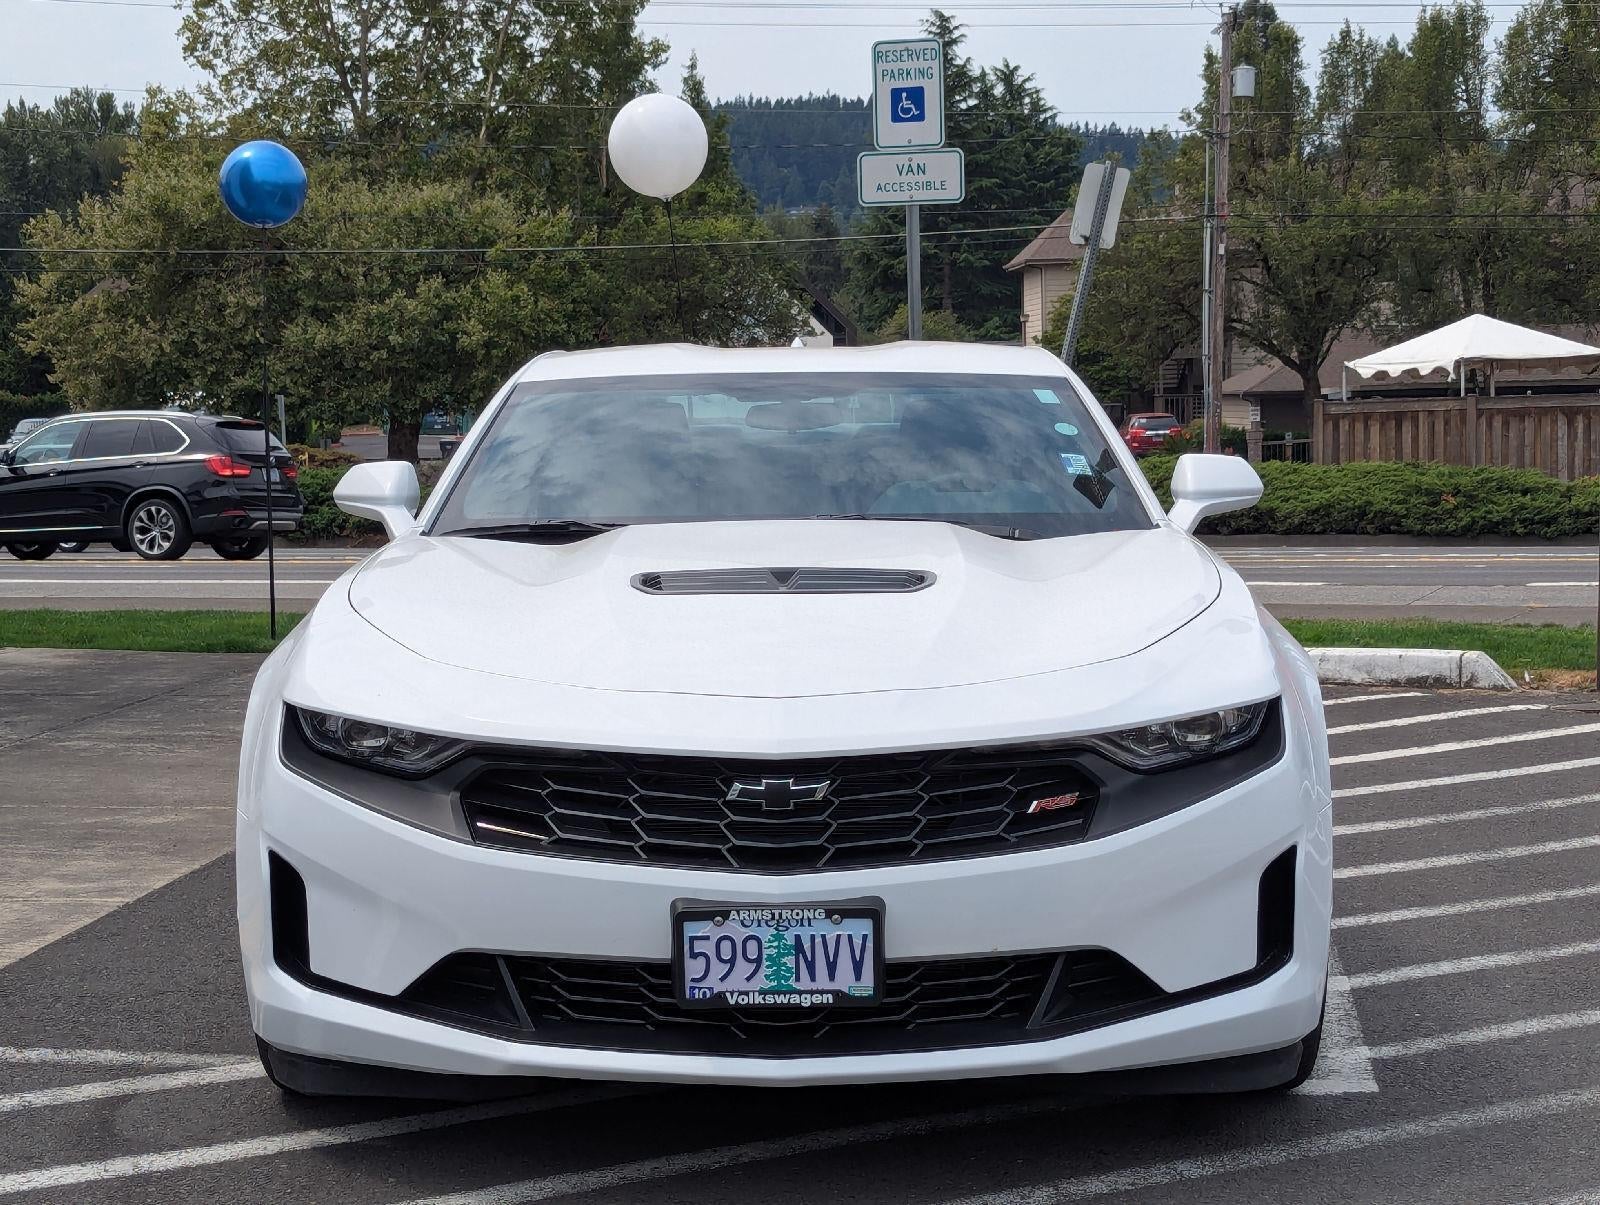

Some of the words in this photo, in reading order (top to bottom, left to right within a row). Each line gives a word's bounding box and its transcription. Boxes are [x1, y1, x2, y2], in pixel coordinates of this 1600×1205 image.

[876, 47, 938, 64] RESERVED
[881, 66, 934, 83] PARKING
[896, 162, 926, 176] VAN
[876, 180, 947, 193] ACCESSIBLE
[1027, 792, 1079, 813] RS
[728, 908, 826, 921] ARMSTRONG
[688, 934, 763, 983] 599
[794, 933, 868, 983] NVV
[725, 991, 833, 1007] Volkswagen
